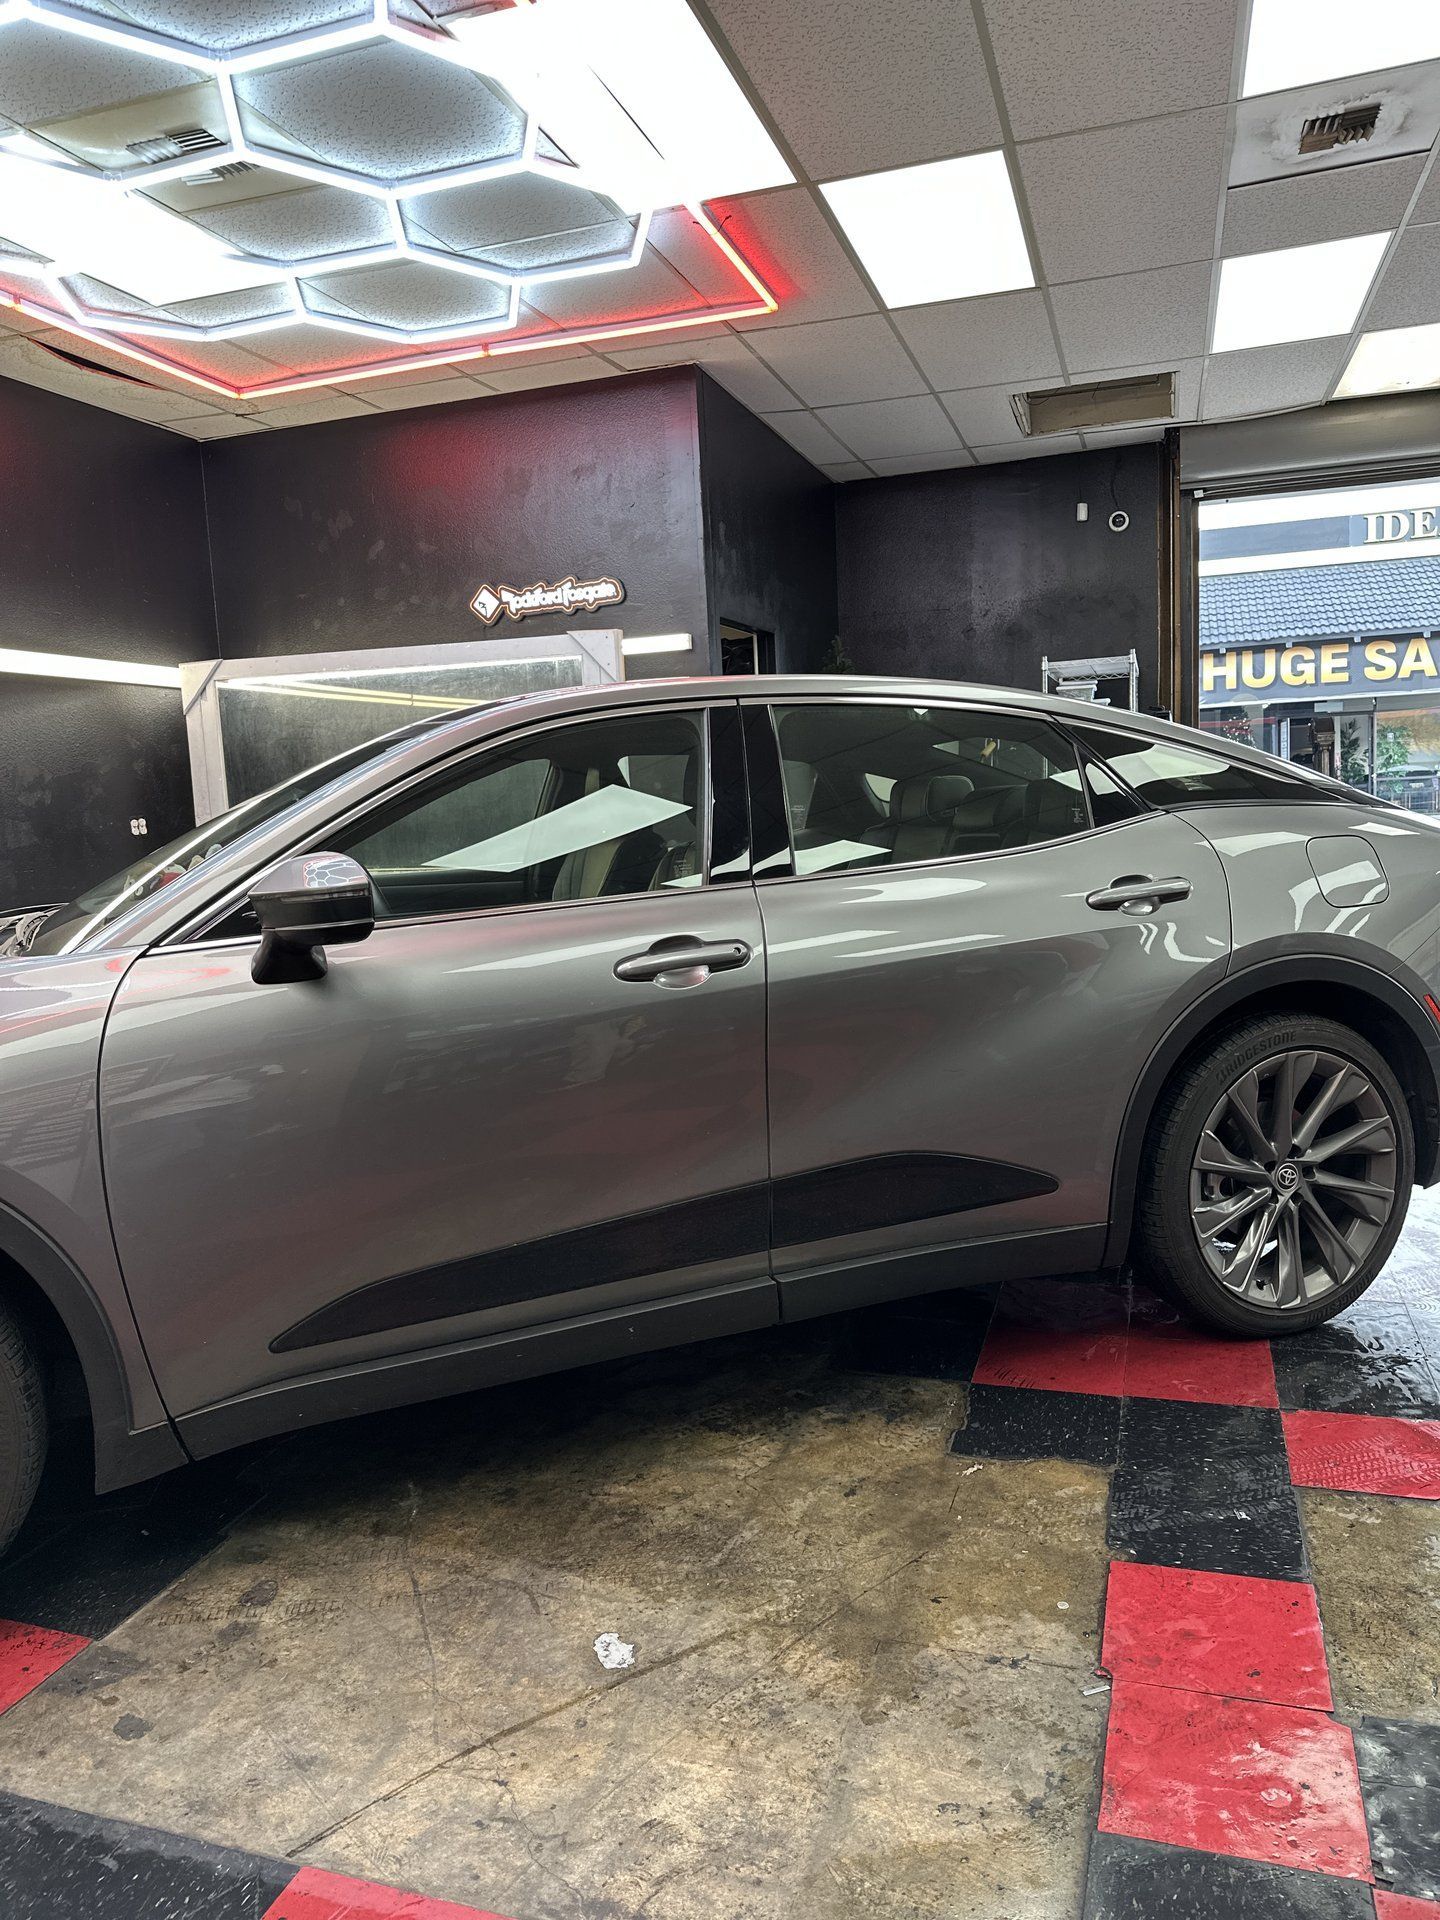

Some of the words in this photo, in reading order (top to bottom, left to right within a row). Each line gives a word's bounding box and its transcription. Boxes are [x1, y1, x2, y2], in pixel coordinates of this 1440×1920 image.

[1363, 507, 1440, 544] IDE
[1202, 643, 1350, 691] HUGE
[1216, 1029, 1297, 1084] BRIDGESTONE
